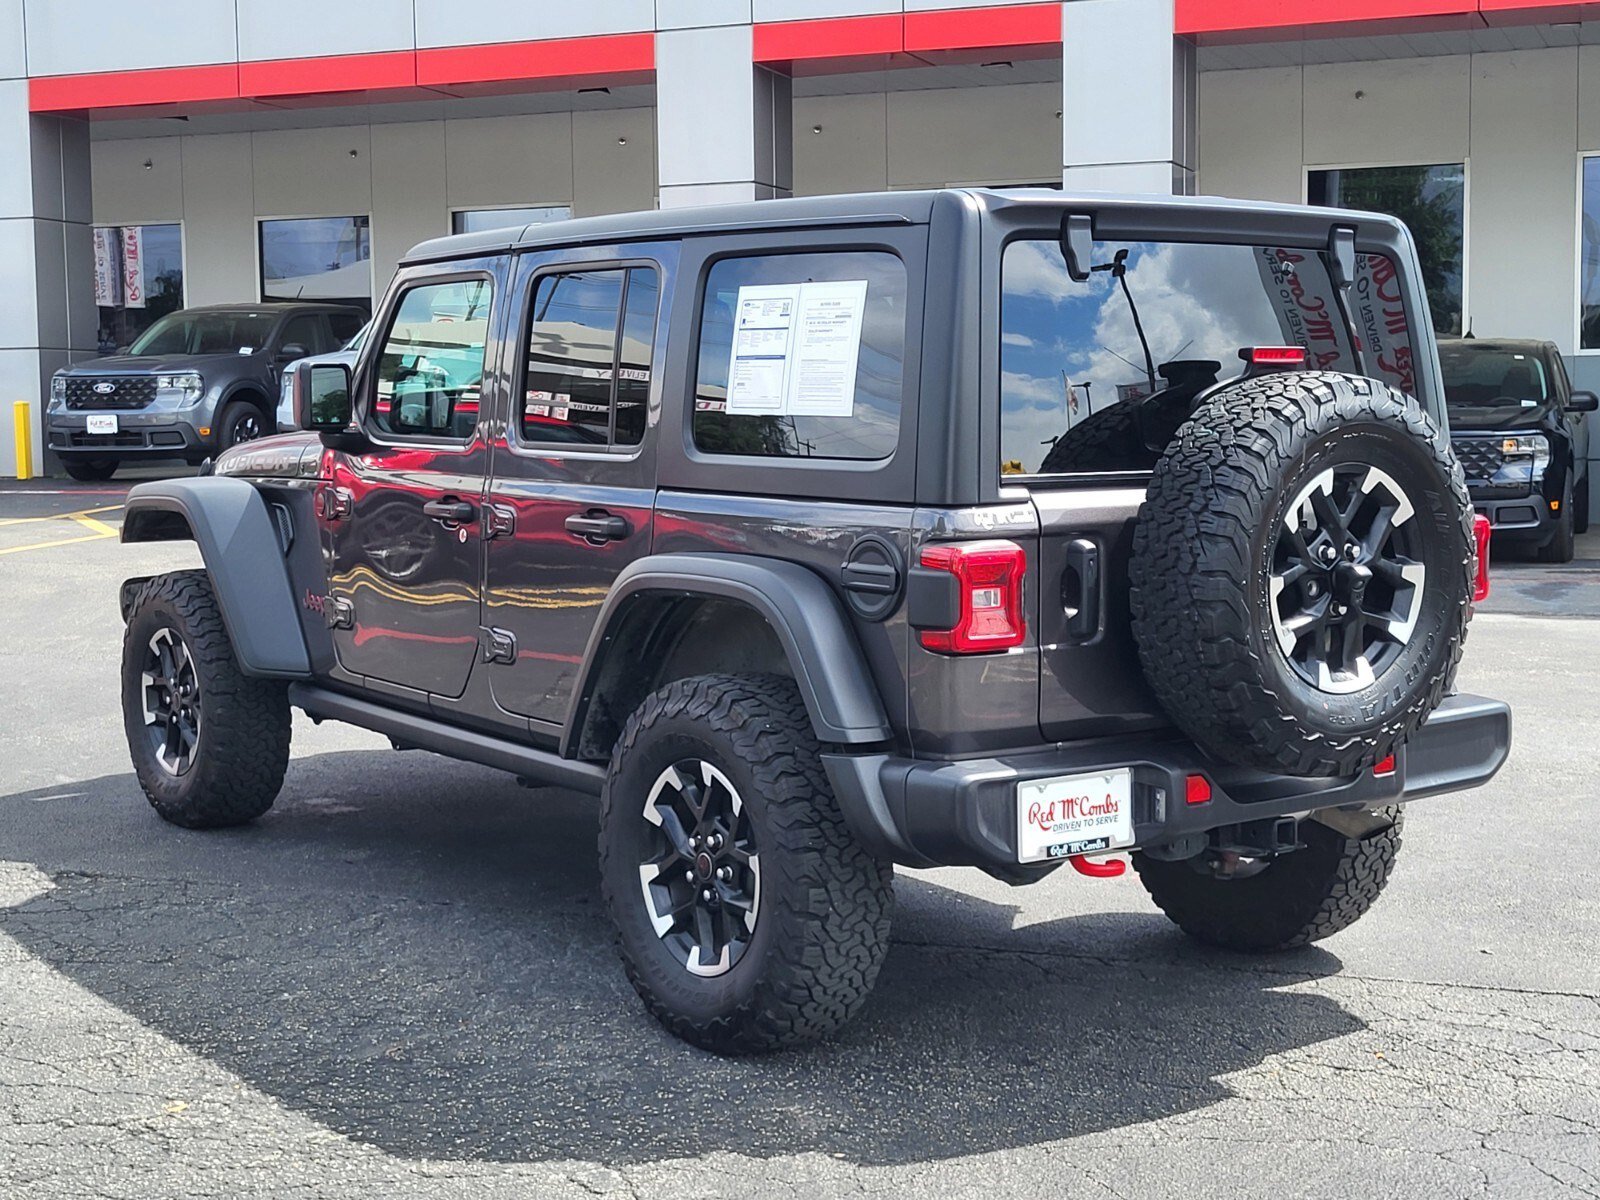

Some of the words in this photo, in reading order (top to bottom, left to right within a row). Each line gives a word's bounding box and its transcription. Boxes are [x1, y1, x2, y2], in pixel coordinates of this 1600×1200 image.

[217, 453, 290, 471] RUBICON
[303, 588, 325, 617] Jeep
[1028, 801, 1056, 831] Red
[1058, 794, 1119, 820] McCombs
[1053, 820, 1081, 833] DRIVEN
[1083, 818, 1094, 828] TO
[1095, 815, 1119, 826] SERVE
[1050, 844, 1069, 857] Red
[1069, 839, 1106, 854] McCombs
